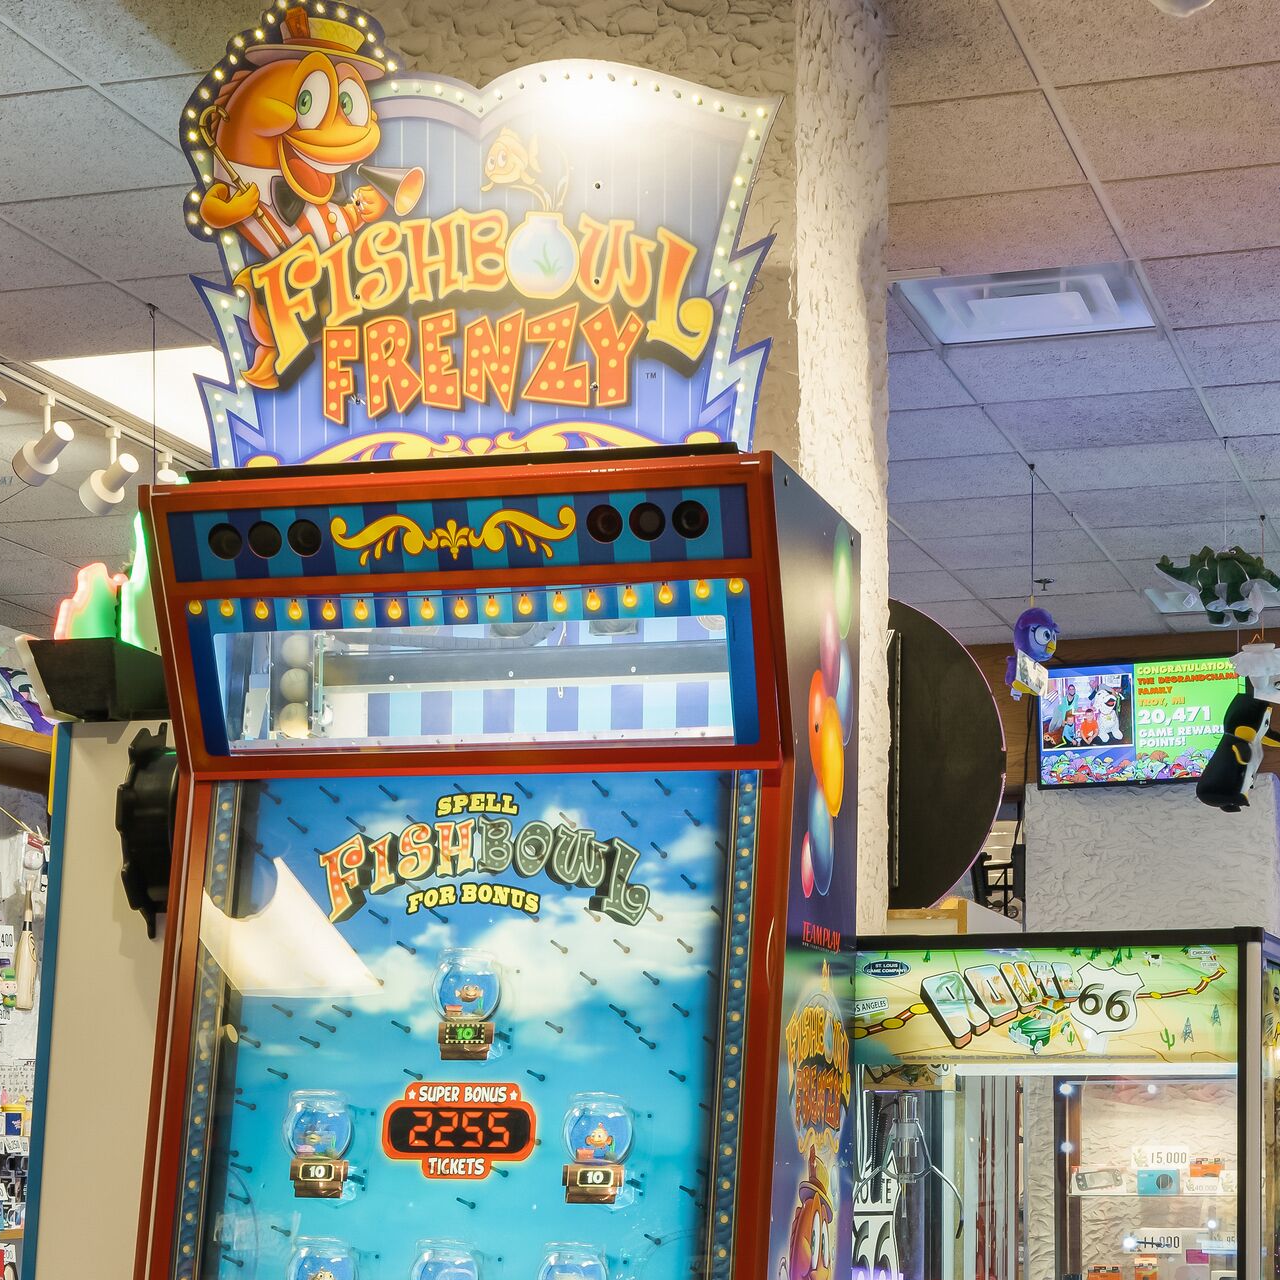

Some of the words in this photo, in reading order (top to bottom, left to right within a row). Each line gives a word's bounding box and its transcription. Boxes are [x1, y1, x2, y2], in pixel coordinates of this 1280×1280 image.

[253, 206, 716, 376] FISHBOWL
[323, 301, 646, 426] FRENZY
[1138, 677, 1155, 685] THE
[1138, 686, 1173, 695] FAMILY
[1172, 697, 1185, 705] MI
[1138, 706, 1212, 725] 20,471
[1140, 727, 1174, 738] GAME
[1140, 737, 1187, 748] POINTS!
[437, 794, 519, 816] SPELL
[319, 816, 651, 926] FISHBOWL
[407, 884, 456, 914] FOR
[462, 884, 540, 914] BONUS
[861, 1000, 888, 1013] ANGELES
[920, 961, 1082, 1050] ROUTE
[1078, 983, 1132, 1023] 66
[456, 1027, 473, 1040] 10
[419, 1086, 460, 1103] SUPER
[464, 1086, 508, 1103] BONUS
[408, 1111, 511, 1148] 2255
[428, 1157, 485, 1176] TICKETS
[1151, 1151, 1187, 1166] 15,000
[310, 1165, 326, 1179] 10
[587, 1171, 604, 1185] 10
